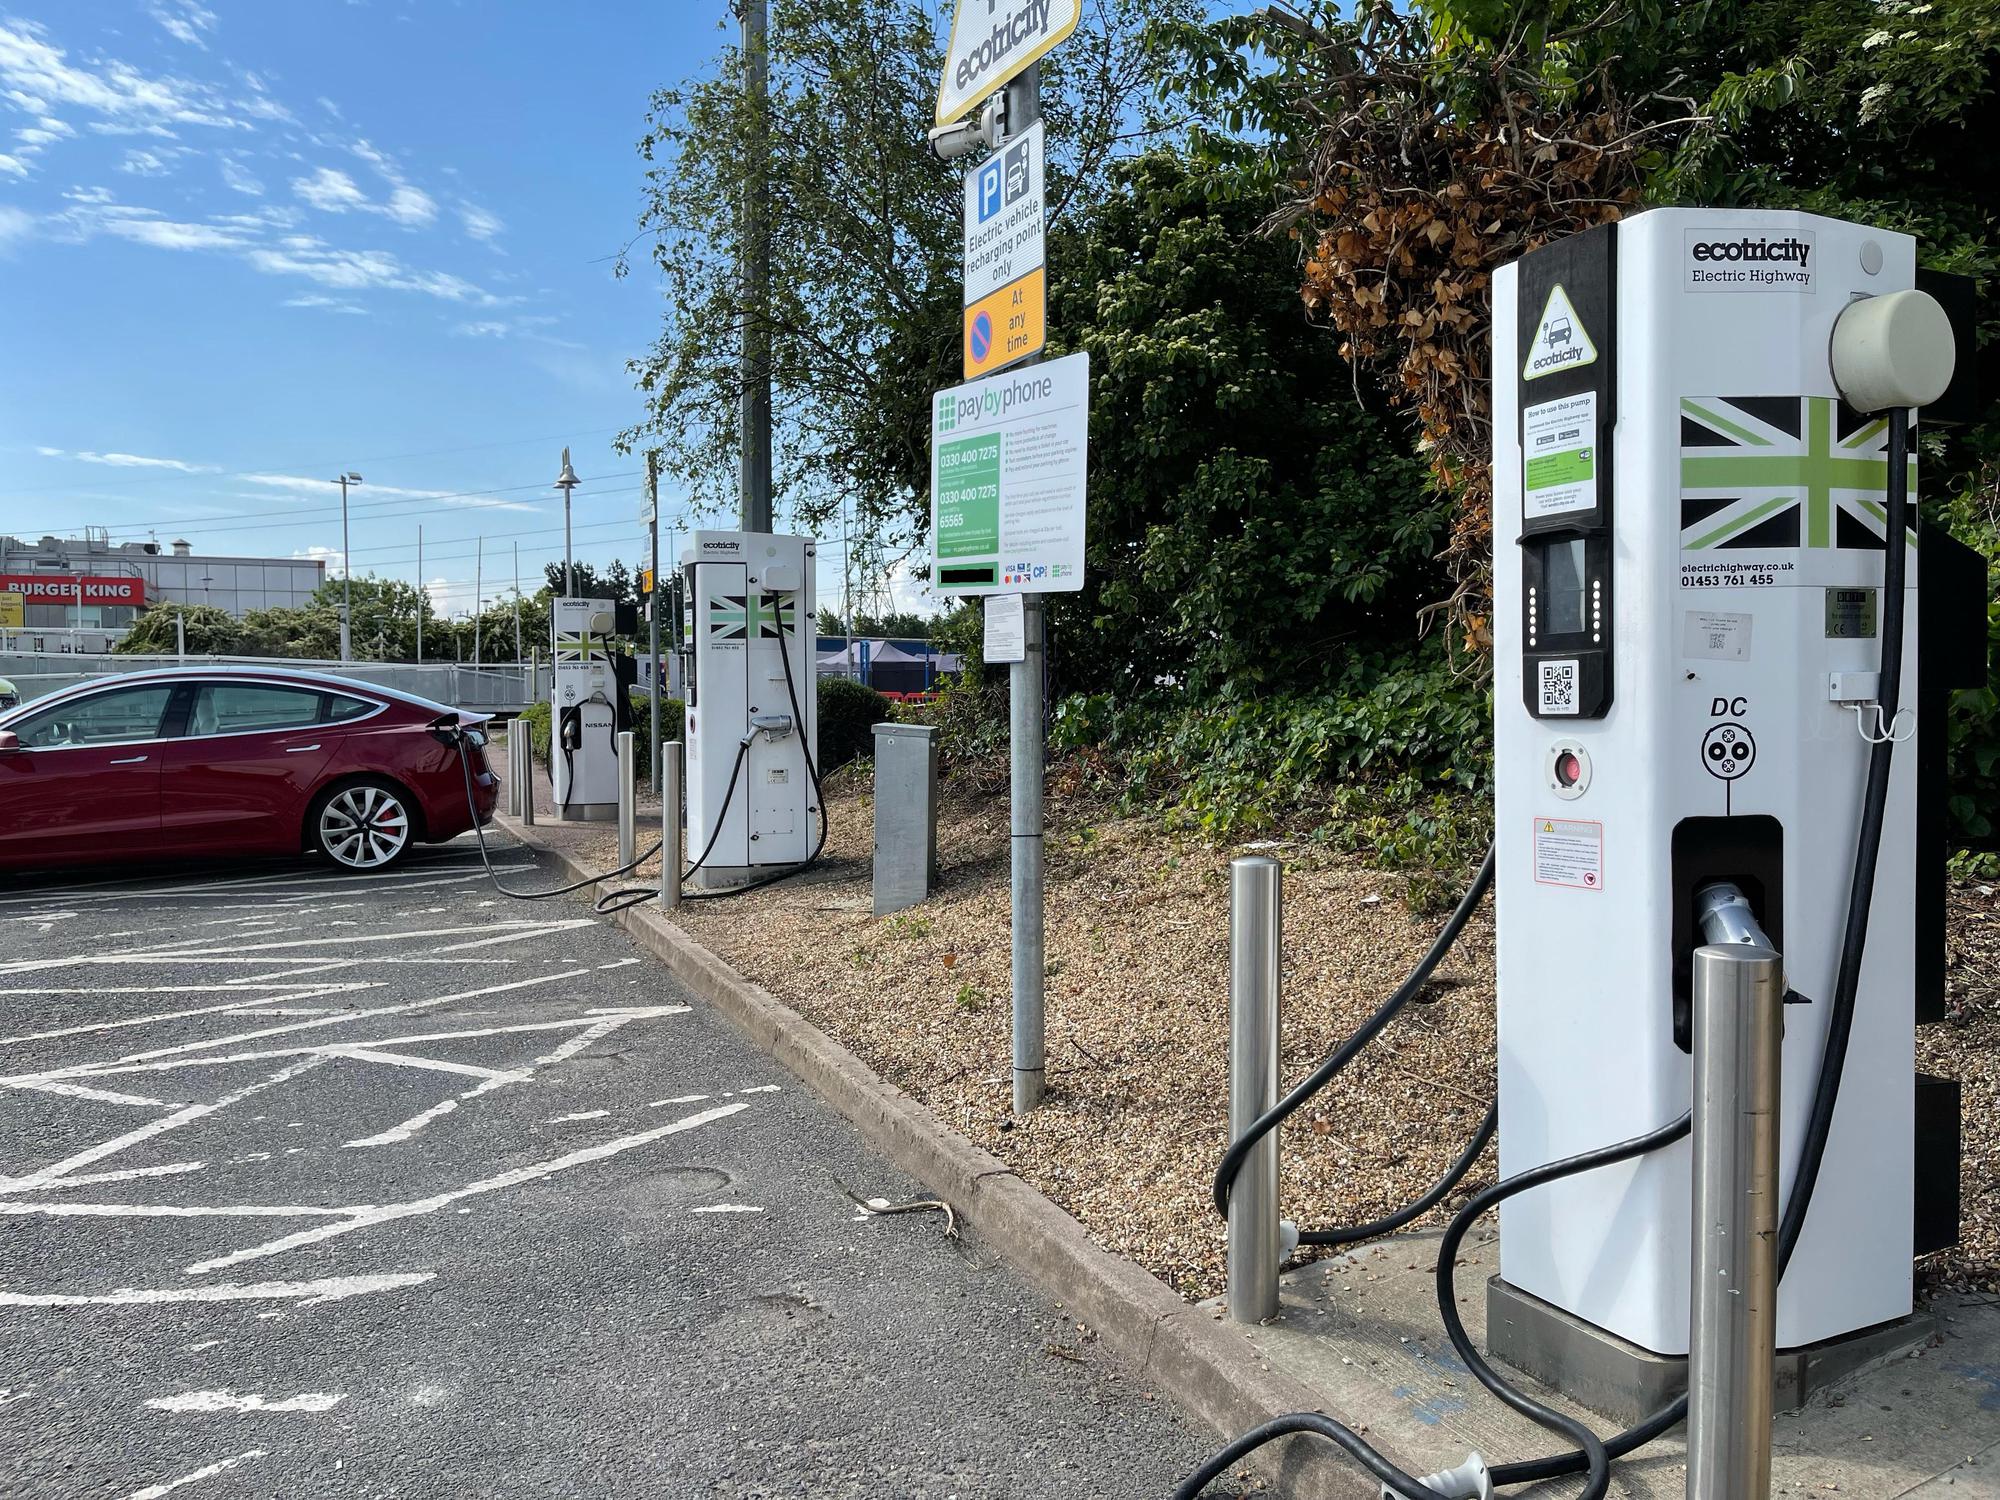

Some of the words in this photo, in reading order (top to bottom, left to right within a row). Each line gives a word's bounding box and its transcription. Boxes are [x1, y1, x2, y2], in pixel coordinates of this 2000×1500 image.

[956, 0, 1050, 90] ecotricity
[983, 168, 998, 217] P
[969, 221, 1003, 253] Electric
[1005, 198, 1039, 230] vehicle
[966, 237, 1013, 275] recharging
[1016, 217, 1041, 249] point
[1693, 237, 1810, 267] ecotricity
[992, 259, 1012, 280] only
[1692, 269, 1746, 282] Electric
[1749, 269, 1811, 285] Highway
[1011, 288, 1023, 307] At
[1008, 313, 1026, 332] any
[1006, 332, 1028, 352] time
[1533, 346, 1584, 370] ecotricity
[957, 377, 1052, 424] paybyphone
[1528, 410, 1539, 418] How
[1558, 402, 1570, 411] this
[1571, 398, 1591, 408] pump
[940, 453, 960, 468] 0330
[961, 449, 978, 464] 400
[978, 445, 998, 461] 7275
[940, 490, 960, 505] 0330
[960, 487, 977, 502] 400
[977, 484, 997, 500] 7275
[940, 513, 964, 528] 65565
[703, 541, 740, 550] ecotricity
[1681, 562, 1795, 574] electrichighway.co.uk
[8, 582, 82, 596] BURGER
[85, 584, 131, 597] KING
[1681, 575, 1719, 587] 01453
[1723, 574, 1745, 586] 761
[1749, 574, 1774, 585] 455
[1711, 696, 1748, 717] DC
